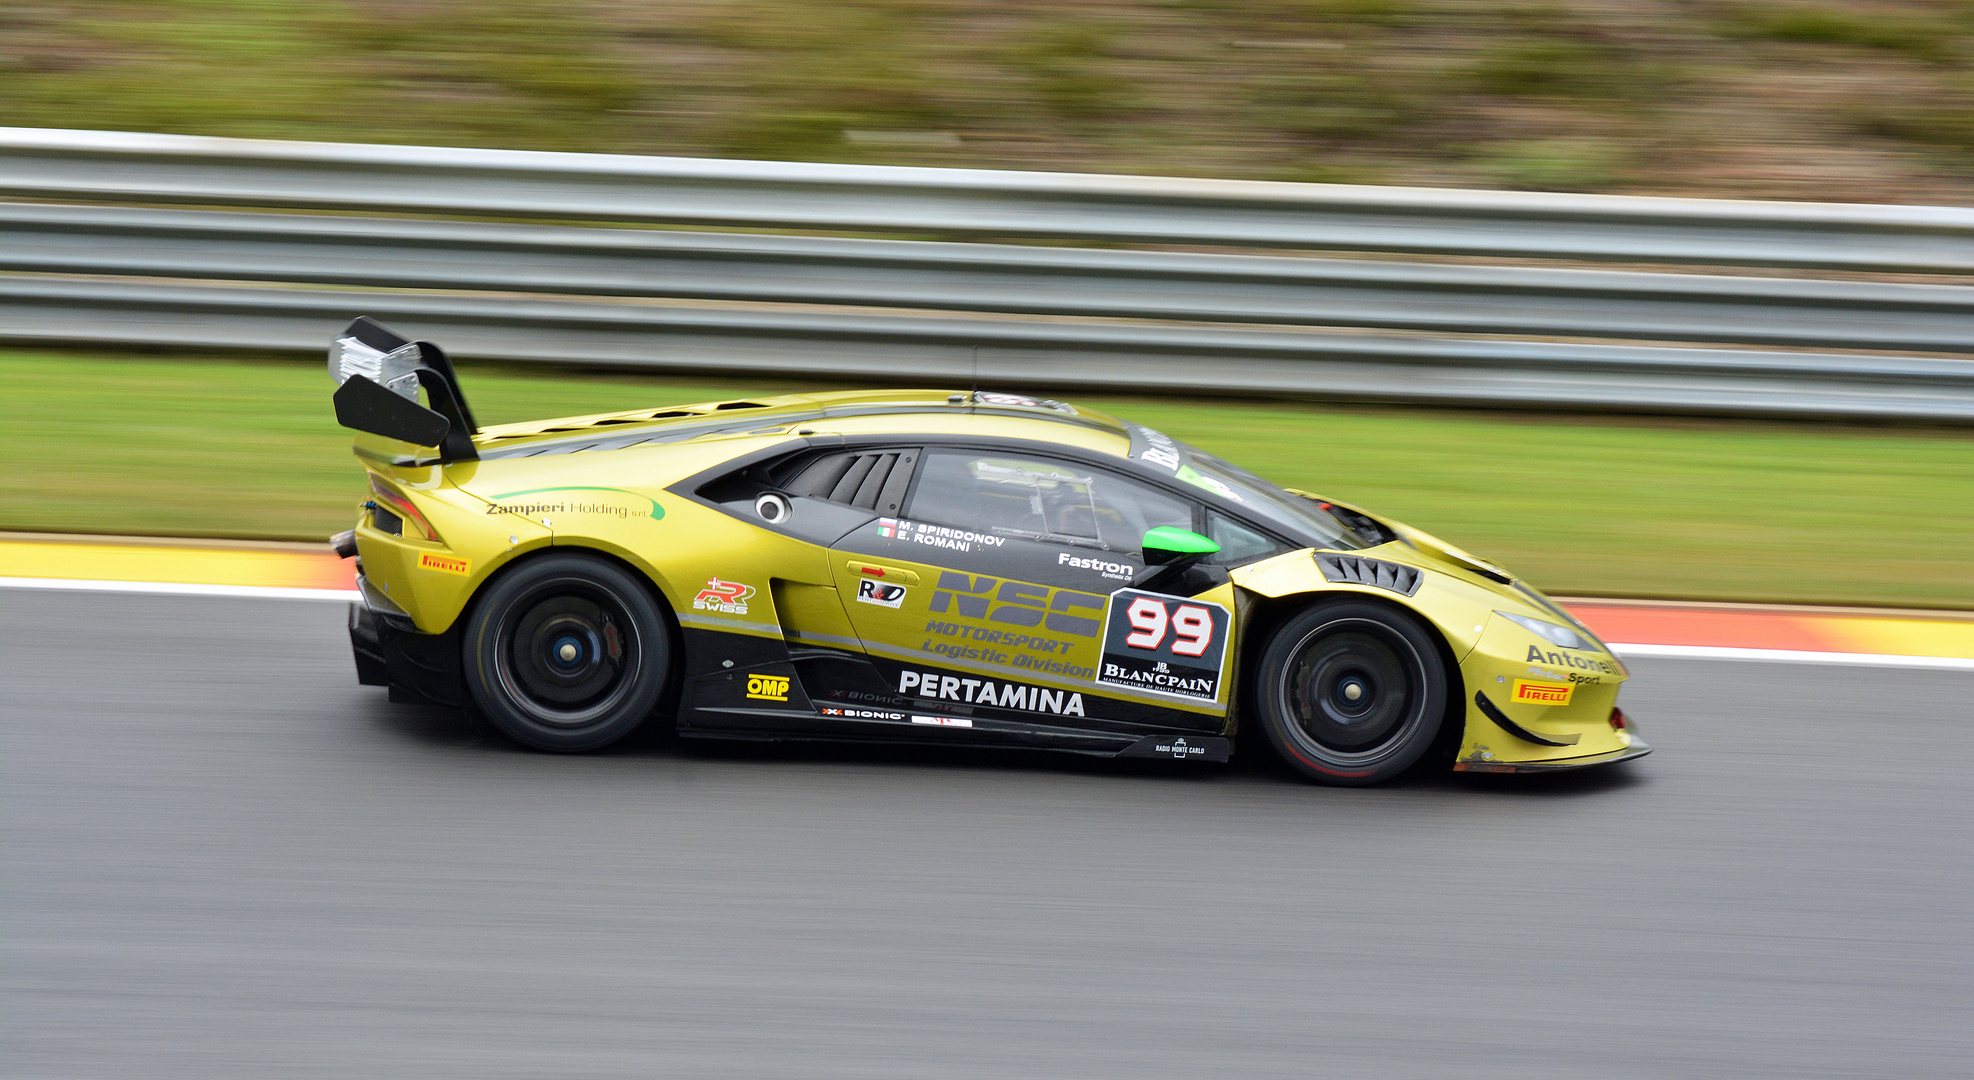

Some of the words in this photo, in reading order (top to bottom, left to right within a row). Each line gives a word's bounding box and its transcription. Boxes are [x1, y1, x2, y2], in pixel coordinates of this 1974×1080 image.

[486, 502, 564, 516] Zampieri
[570, 503, 628, 519] Holding
[896, 529, 910, 541] E.
[913, 532, 970, 552] ROMANI
[898, 520, 914, 531] M.
[917, 524, 1006, 547] SPIRIDONOV
[1058, 552, 1134, 576] Fastron
[692, 600, 748, 615] SWISS
[925, 620, 1074, 655] MOTORSPORT
[1125, 596, 1214, 657] 99
[922, 638, 1009, 664] Logistic
[1011, 653, 1095, 678] Division
[747, 678, 789, 697] OMP
[1103, 677, 1144, 689] MANUFACTURE
[1104, 663, 1214, 693] BLANCPAIN
[898, 670, 1086, 717] PERTAMINA
[1518, 684, 1570, 701] PIRELLI
[1155, 744, 1171, 752] RADIO
